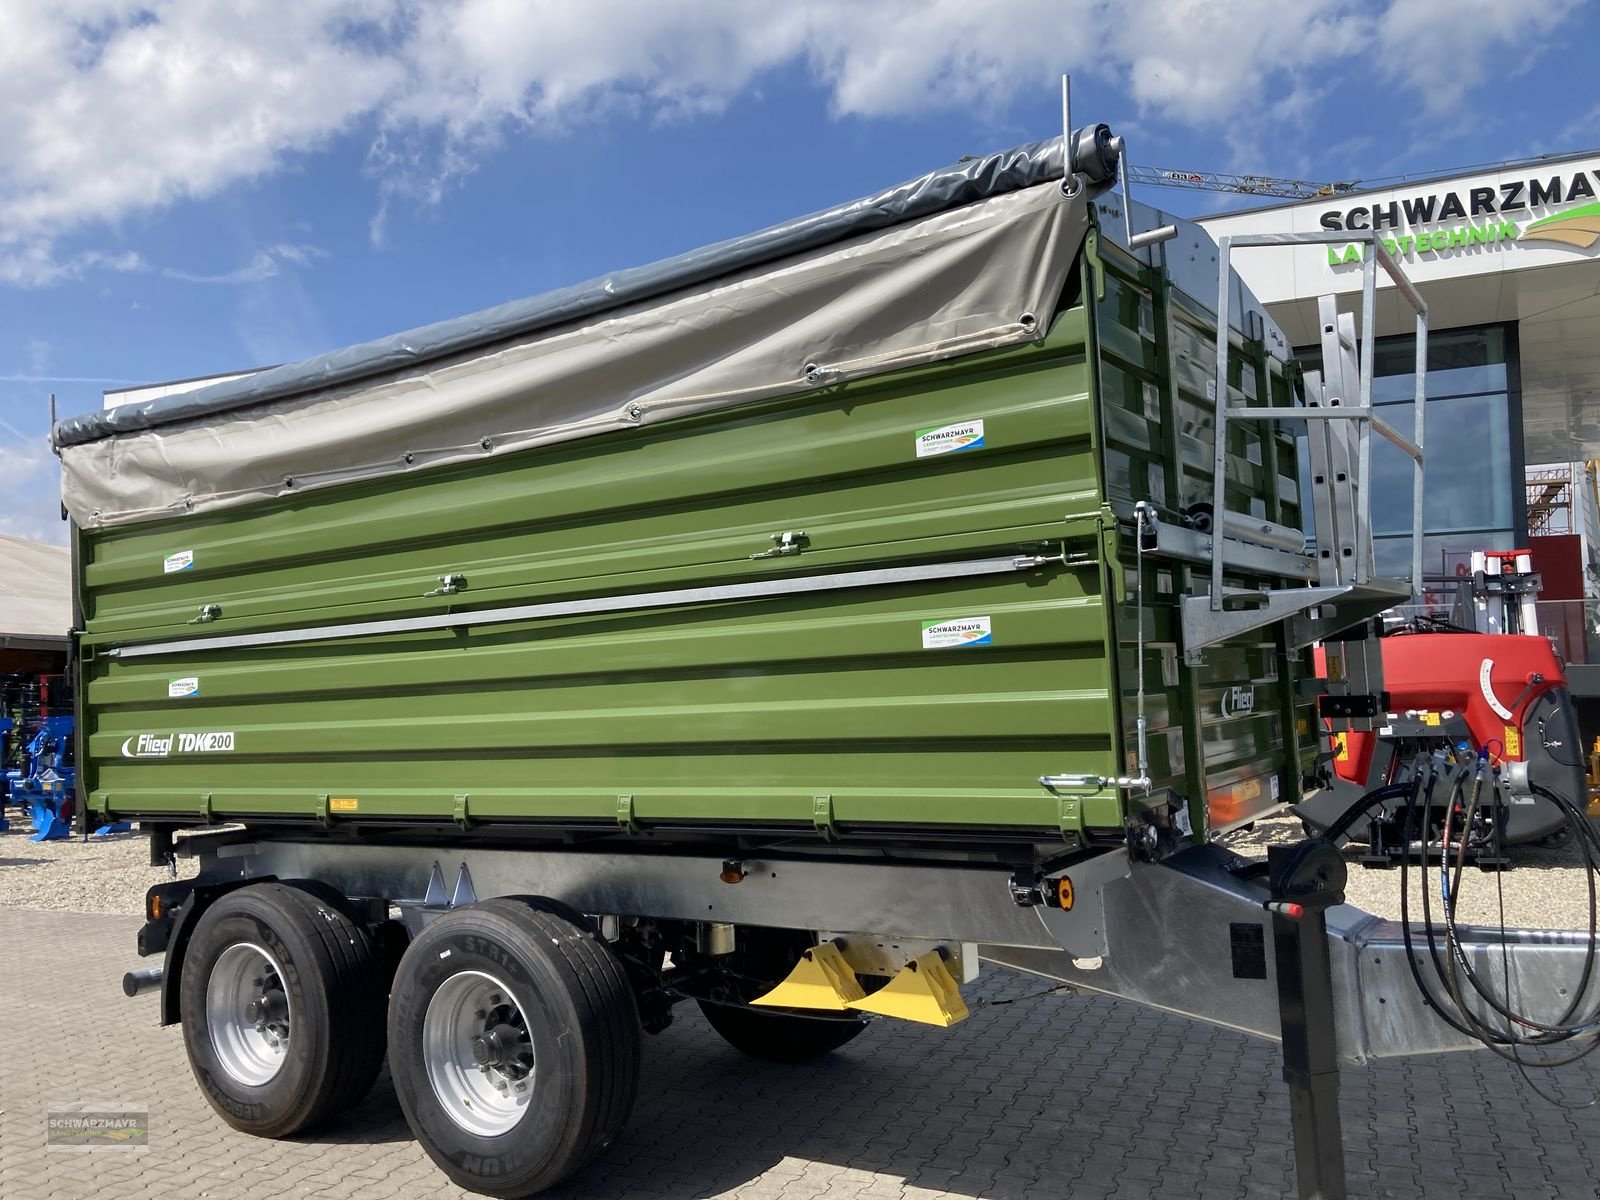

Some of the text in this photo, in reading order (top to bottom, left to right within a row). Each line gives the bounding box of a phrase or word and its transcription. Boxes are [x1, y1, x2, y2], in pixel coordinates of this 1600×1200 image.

[1320, 169, 1600, 231] SCHWARZMA
[1328, 220, 1517, 266] LADTECHNIK
[922, 428, 974, 442] SCHWARZMAYR
[928, 624, 981, 633] SCHWARZMAYR
[1231, 685, 1254, 714] Fliegl
[136, 733, 232, 756] Fliegl TDK 200
